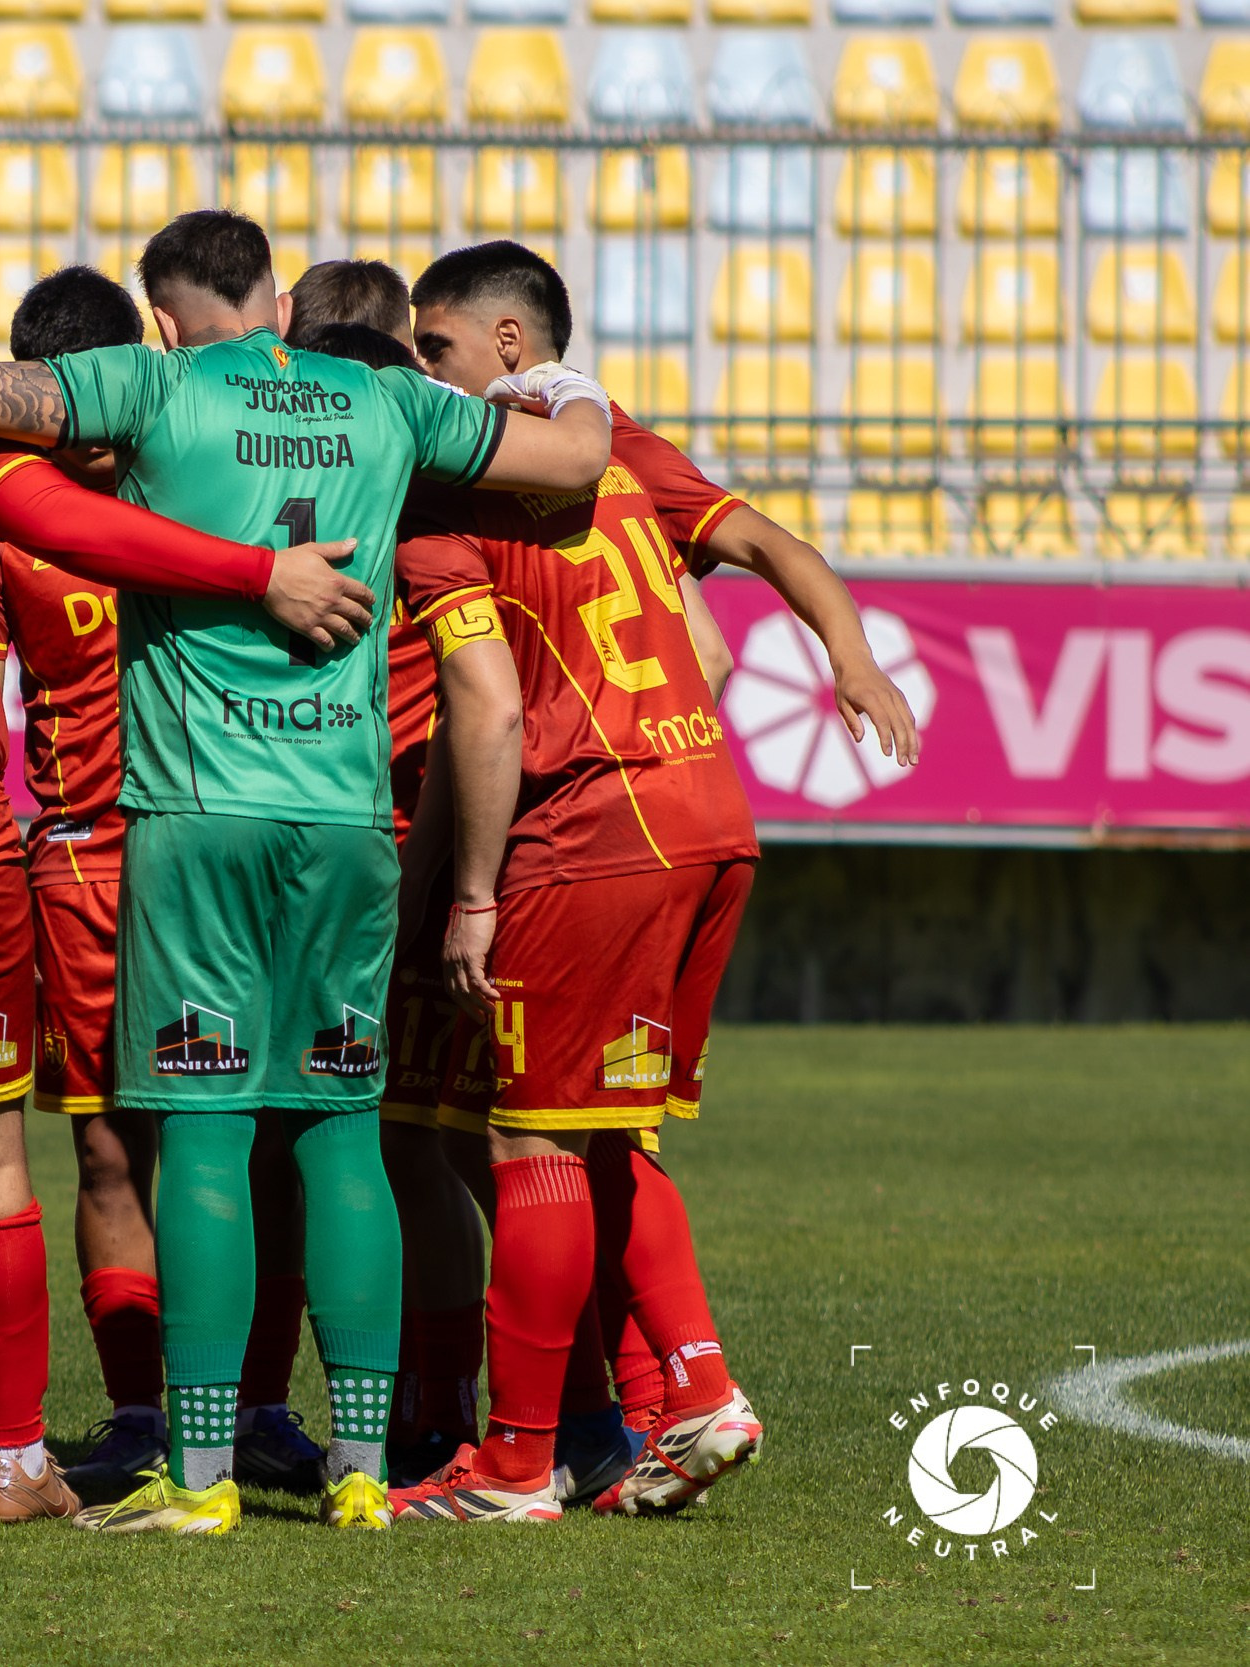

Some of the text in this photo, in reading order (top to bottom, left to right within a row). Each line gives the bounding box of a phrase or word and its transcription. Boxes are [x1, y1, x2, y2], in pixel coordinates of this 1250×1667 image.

[224, 373, 325, 395] LIQUIDADORA
[245, 391, 352, 416] JUANITO
[235, 429, 355, 470] QUIROGA
[274, 497, 317, 667] 1
[552, 517, 701, 694] 24
[222, 688, 322, 732] fmd
[964, 625, 1250, 784] VIS
[223, 731, 263, 741] fisioterapia
[294, 737, 322, 745] deporte
